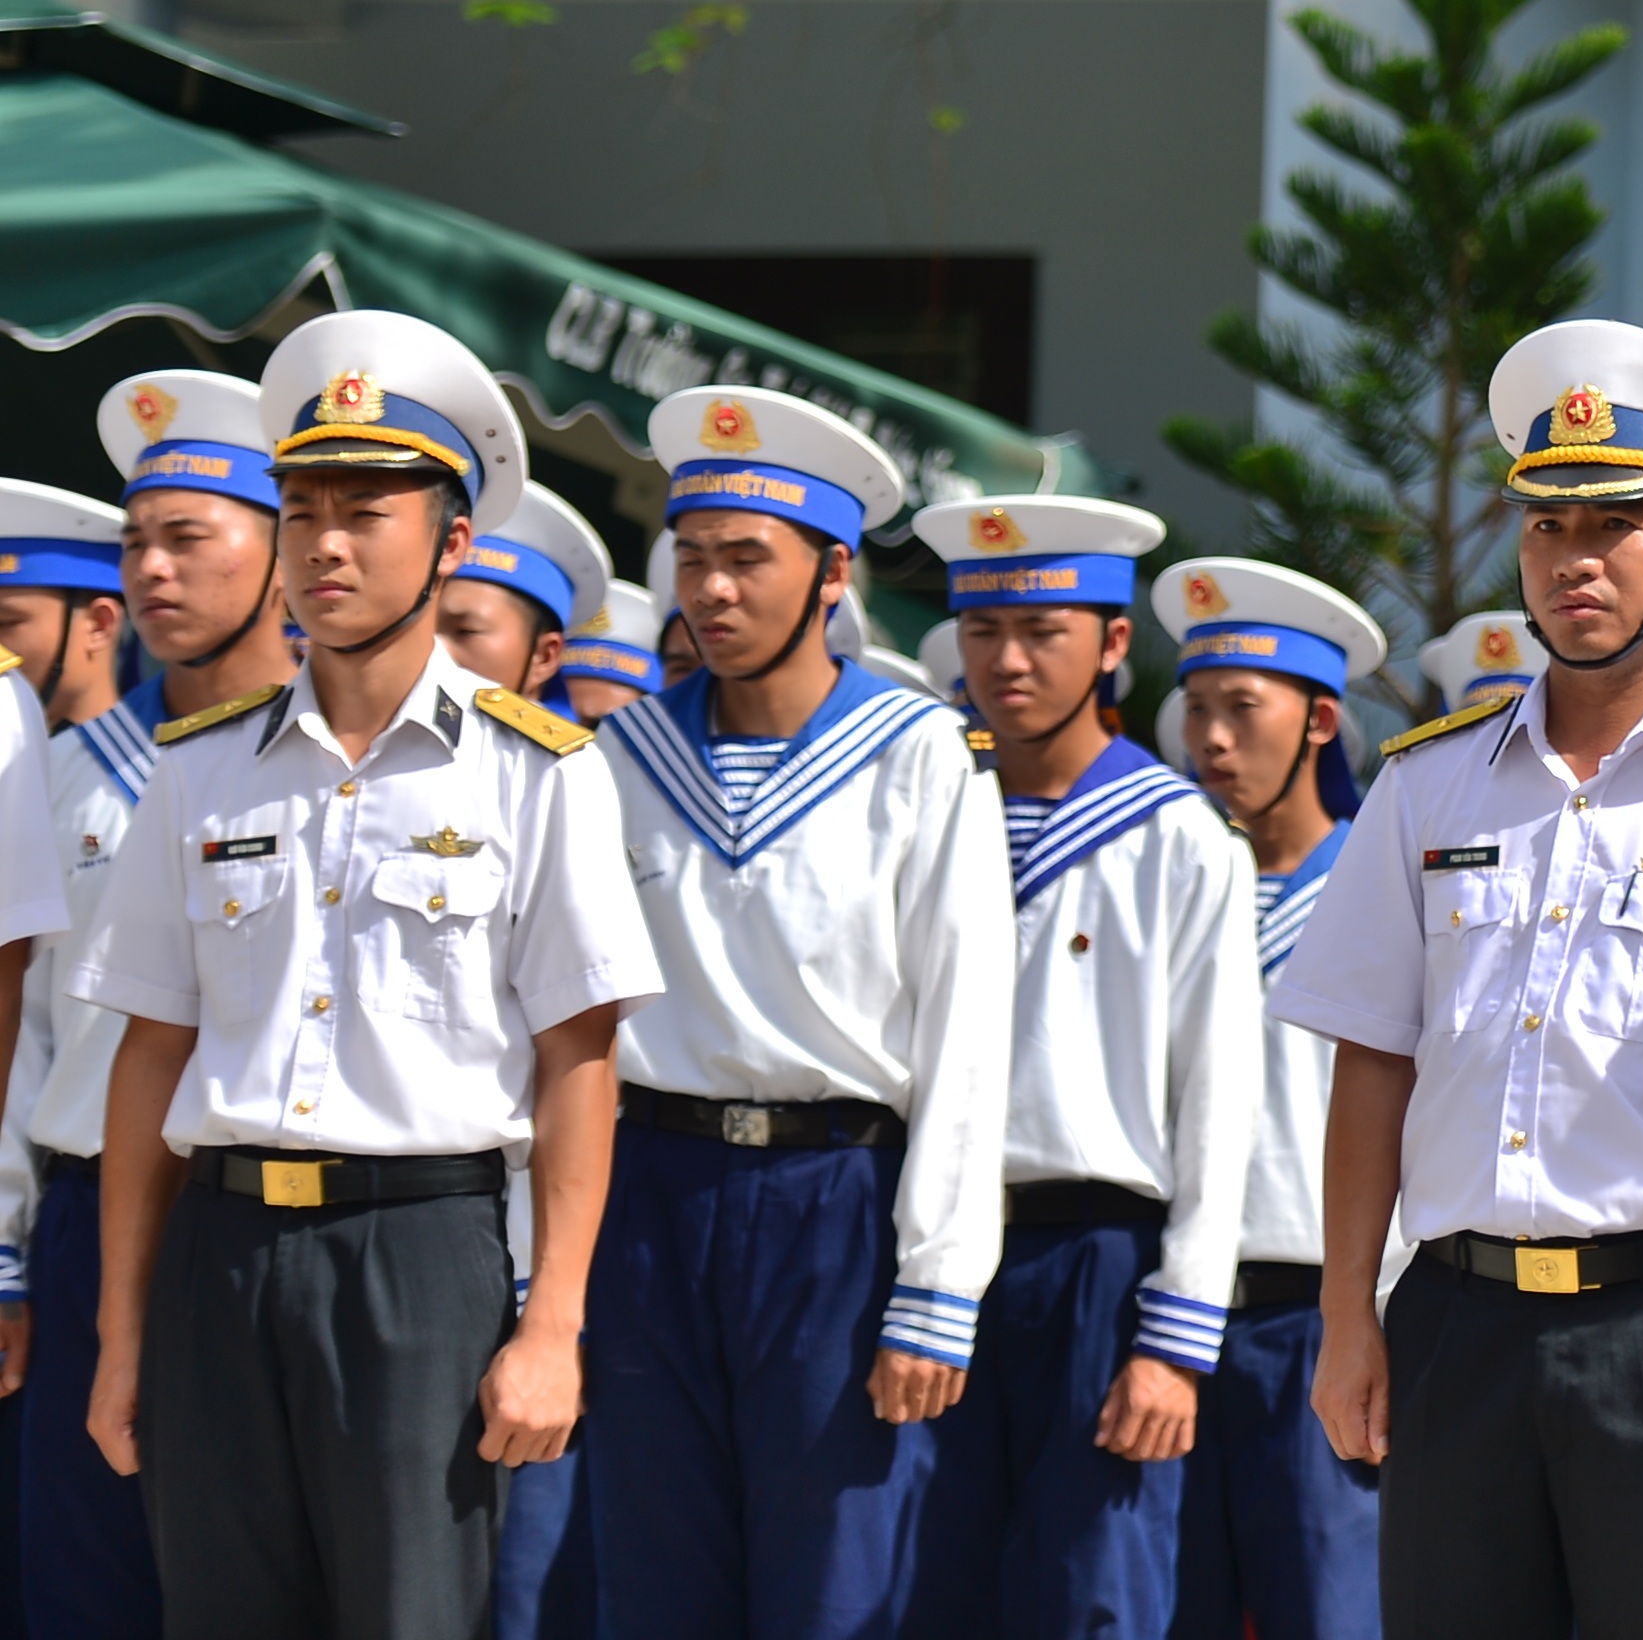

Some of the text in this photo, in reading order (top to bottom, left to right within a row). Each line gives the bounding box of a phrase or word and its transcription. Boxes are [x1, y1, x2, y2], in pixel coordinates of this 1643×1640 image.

[723, 471, 764, 499] VIỆT
[764, 477, 807, 507] NAM
[1039, 568, 1078, 591] NAM
